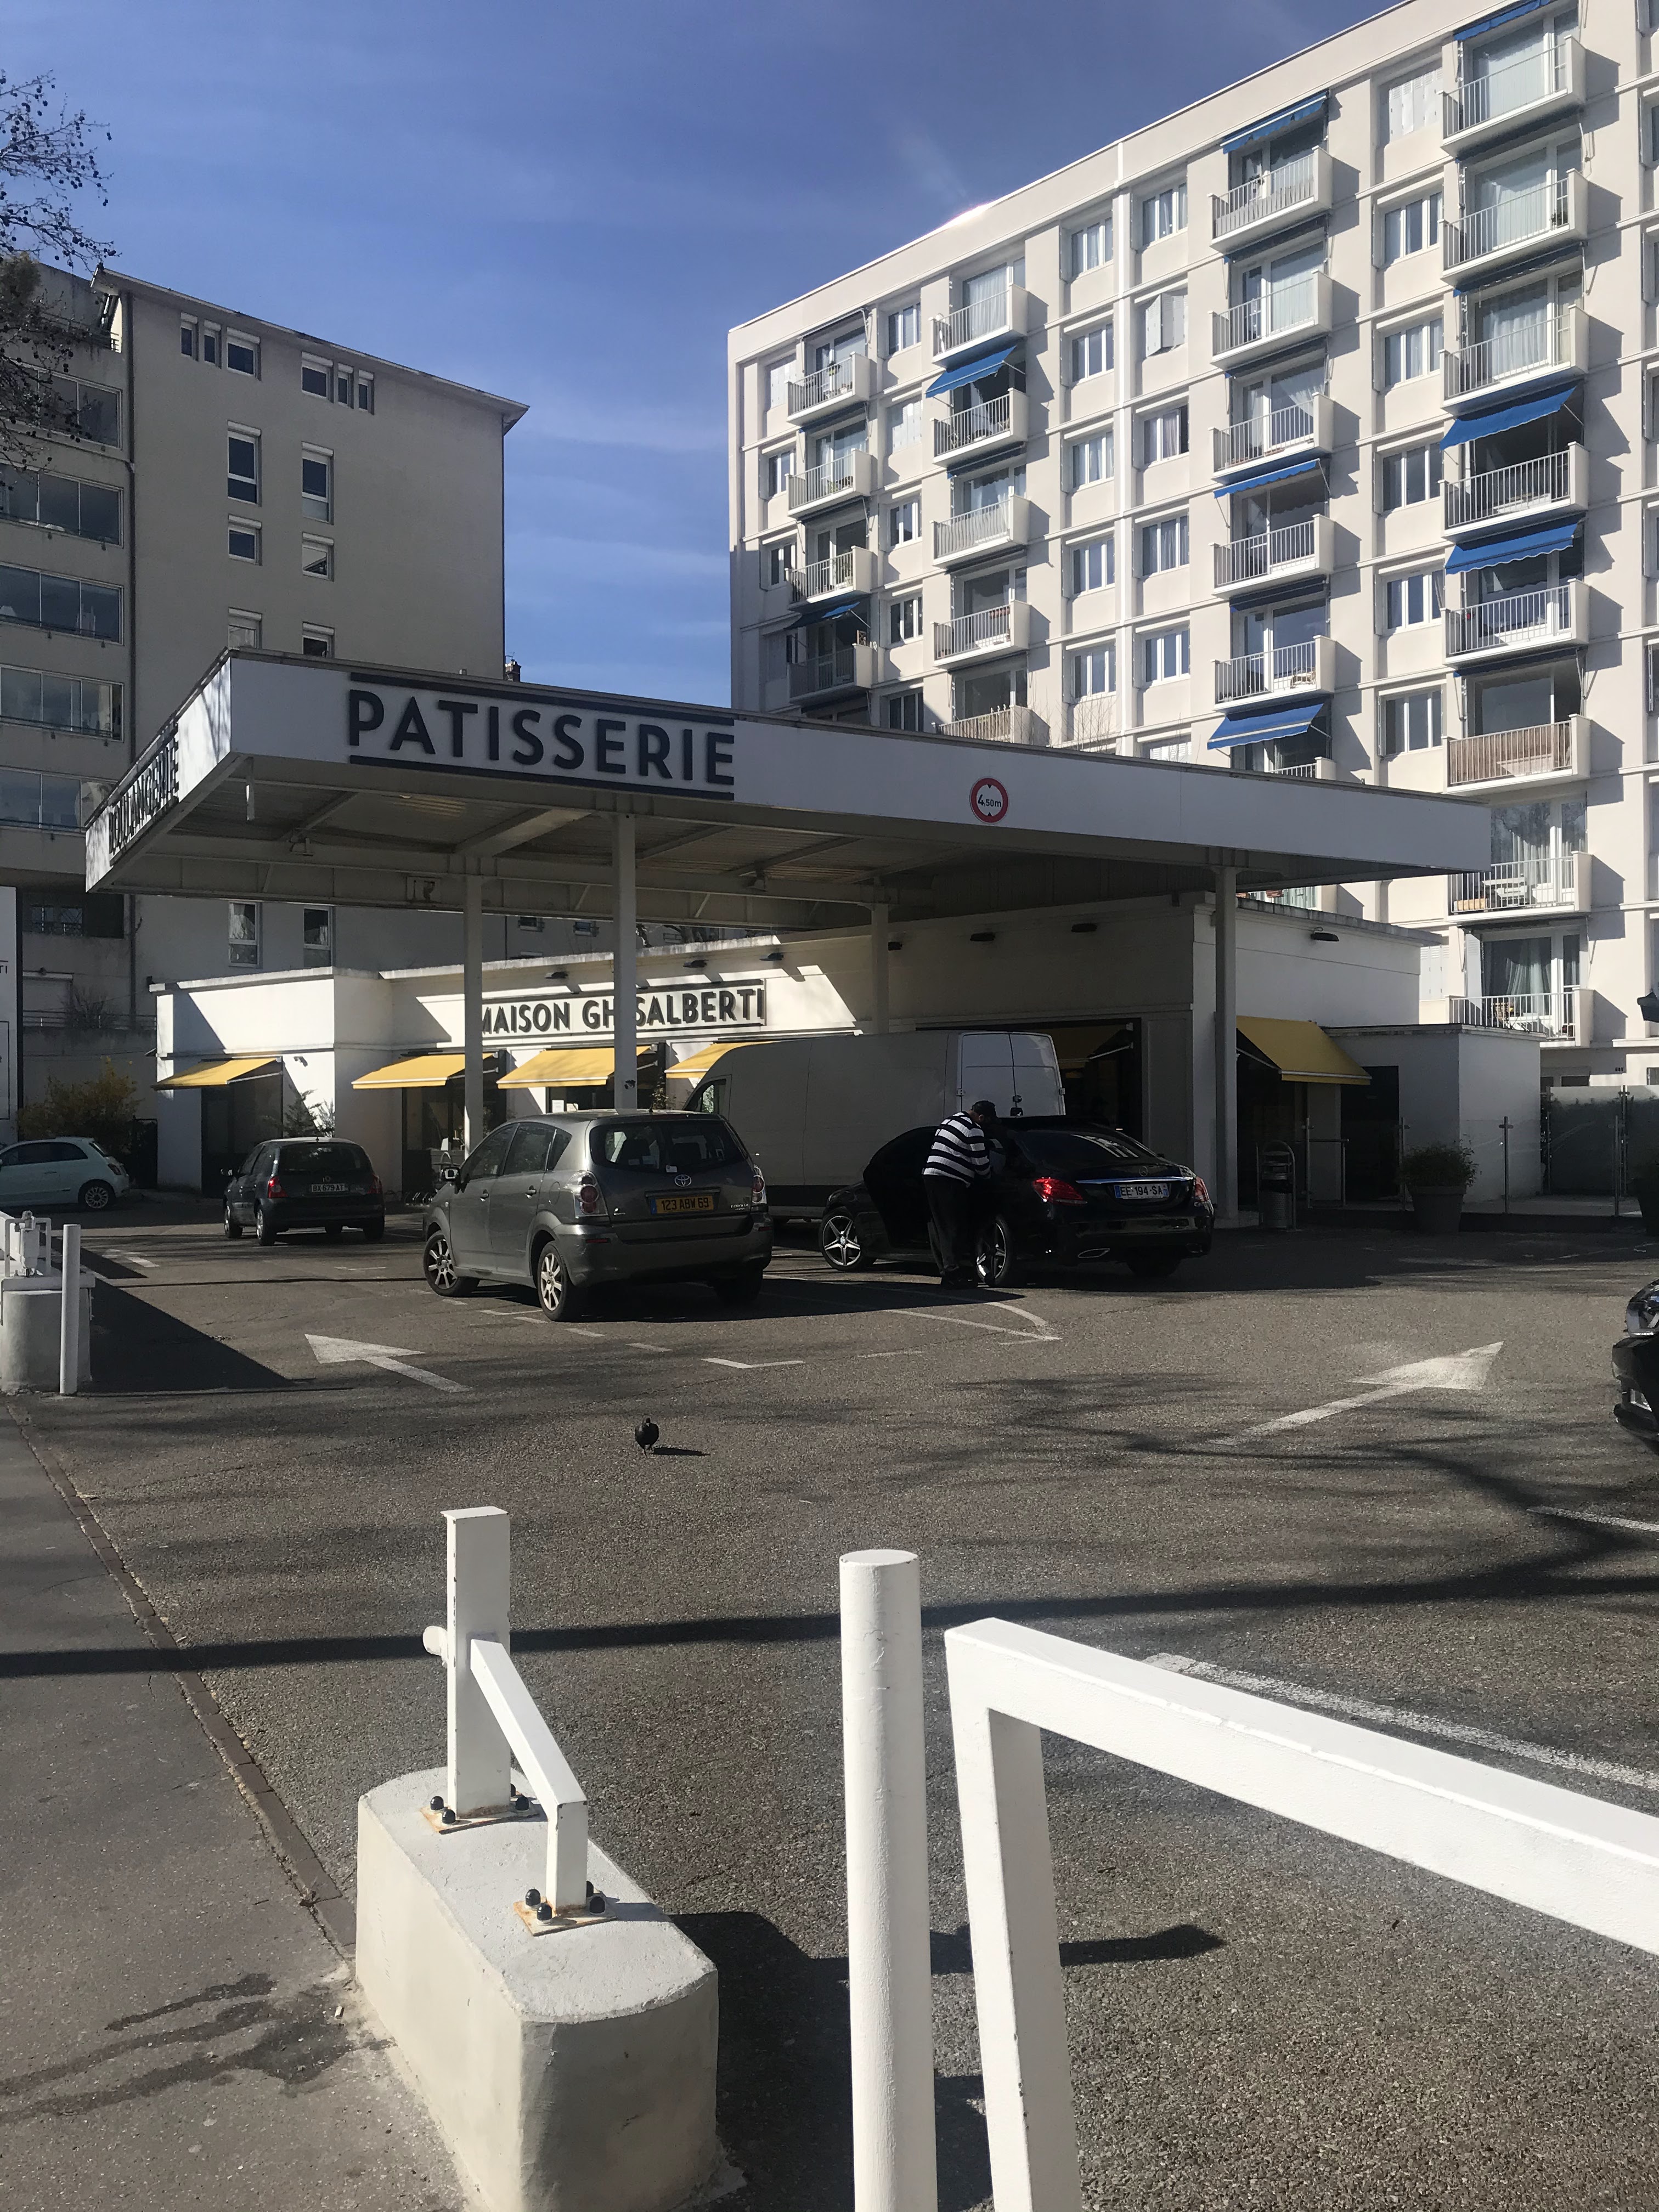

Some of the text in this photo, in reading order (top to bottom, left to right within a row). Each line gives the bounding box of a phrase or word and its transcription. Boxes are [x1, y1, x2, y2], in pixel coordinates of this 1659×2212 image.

[350, 689, 735, 786] PATISSERIE
[109, 737, 179, 854] BOULANGERIE
[582, 988, 765, 1030] GHSALBERTI
[662, 1197, 709, 1211] 123 ABW 69
